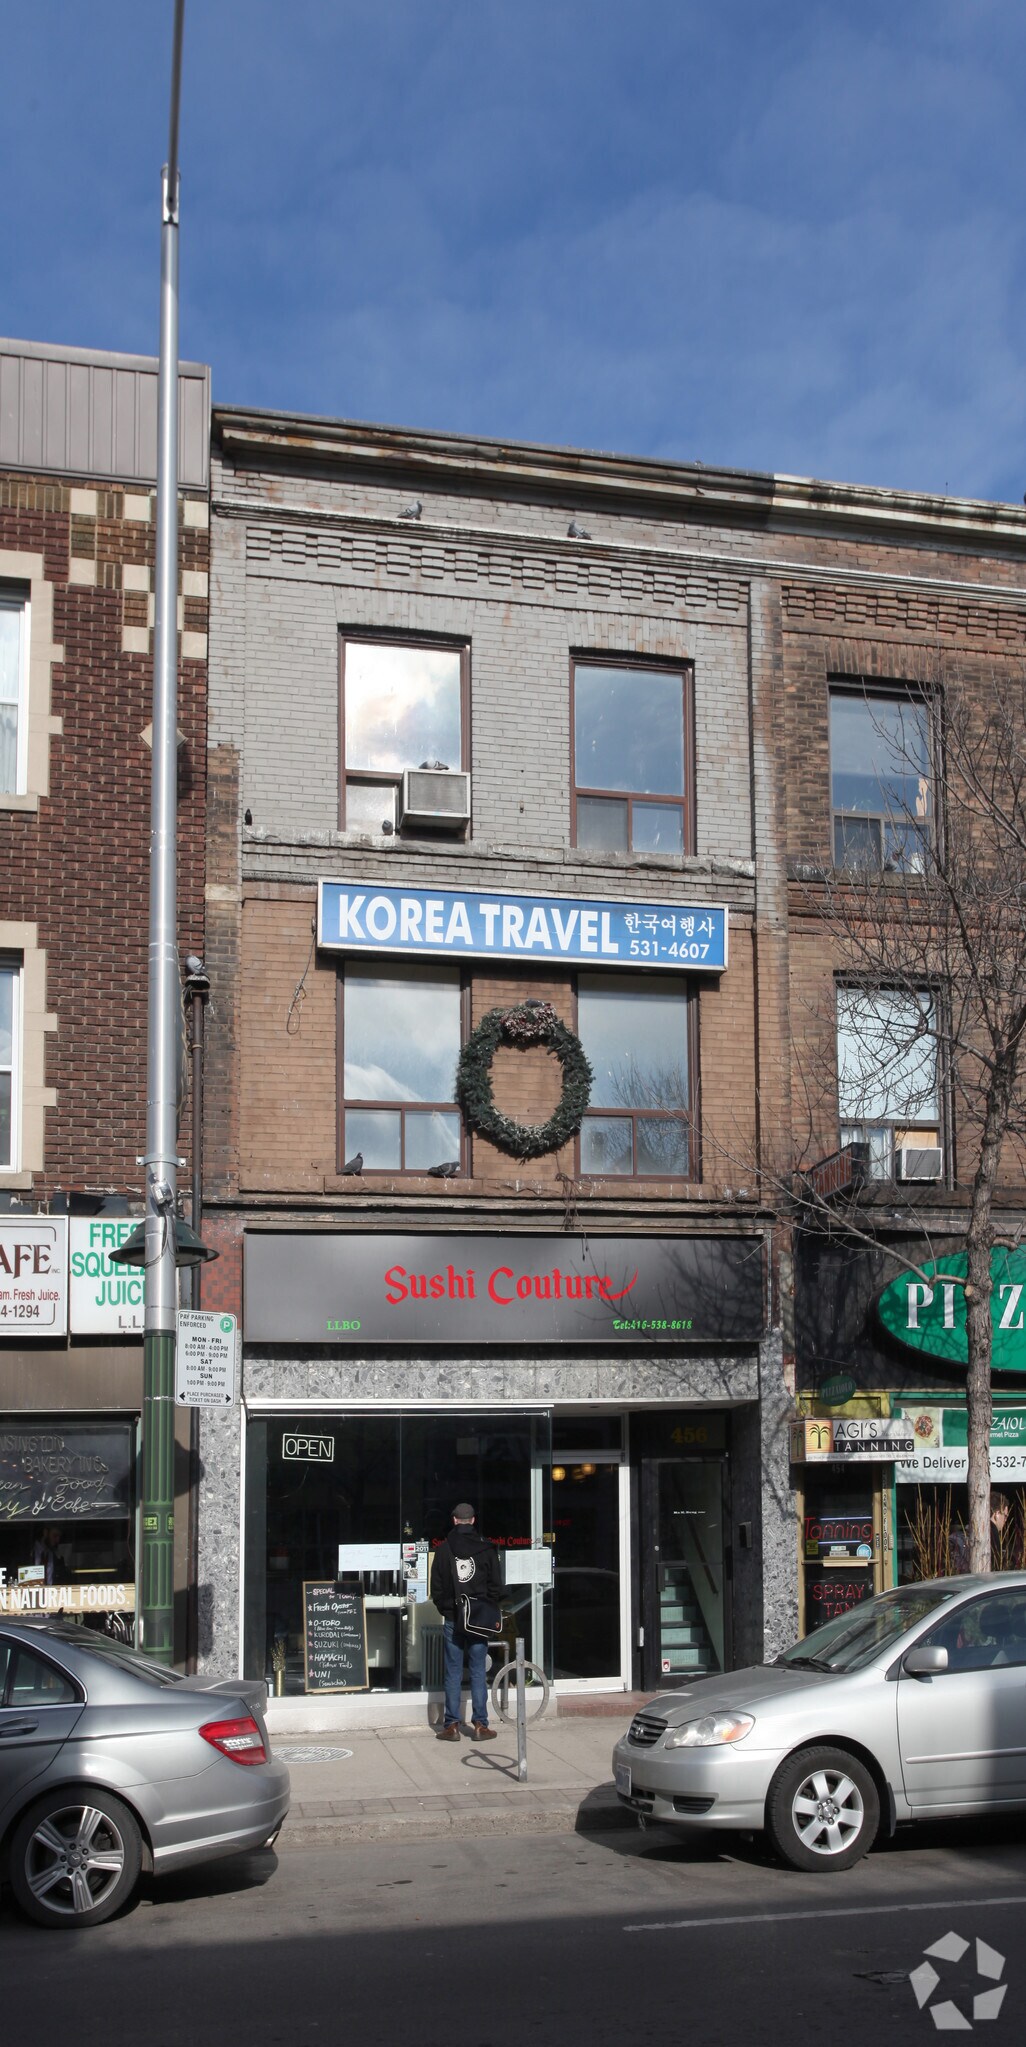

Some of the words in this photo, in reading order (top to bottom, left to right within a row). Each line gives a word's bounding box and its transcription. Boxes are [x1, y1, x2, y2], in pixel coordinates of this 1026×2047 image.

[339, 894, 473, 944] KOREA
[479, 904, 619, 954] TRAVEL
[624, 913, 716, 938] 한국여행사
[630, 940, 710, 959] 531-4607
[95, 1280, 145, 1306] JUIC
[384, 1265, 475, 1305] Sushi
[487, 1266, 639, 1305] Couture
[14, 1289, 35, 1301] Fresh
[38, 1289, 61, 1301] Juice.
[1, 1304, 40, 1318] 4-1294
[191, 1314, 214, 1322] PARKING
[326, 1320, 361, 1331] LLBO
[671, 1426, 708, 1444] 456
[835, 1422, 878, 1438] AGI'S
[285, 1439, 331, 1457] OPEN
[835, 1441, 914, 1451] TANNING
[23, 1456, 75, 1473] BAKERY
[900, 1458, 919, 1468] We
[923, 1456, 966, 1468] Deliver
[804, 1517, 874, 1544] Tanning
[11, 1585, 77, 1610] NATURAL
[80, 1584, 130, 1607] FOODS.
[813, 1584, 866, 1600] SPRAY
[313, 1640, 339, 1649] SUZUKI
[314, 1652, 347, 1662] HAMACHI
[314, 1670, 331, 1679] UNI
